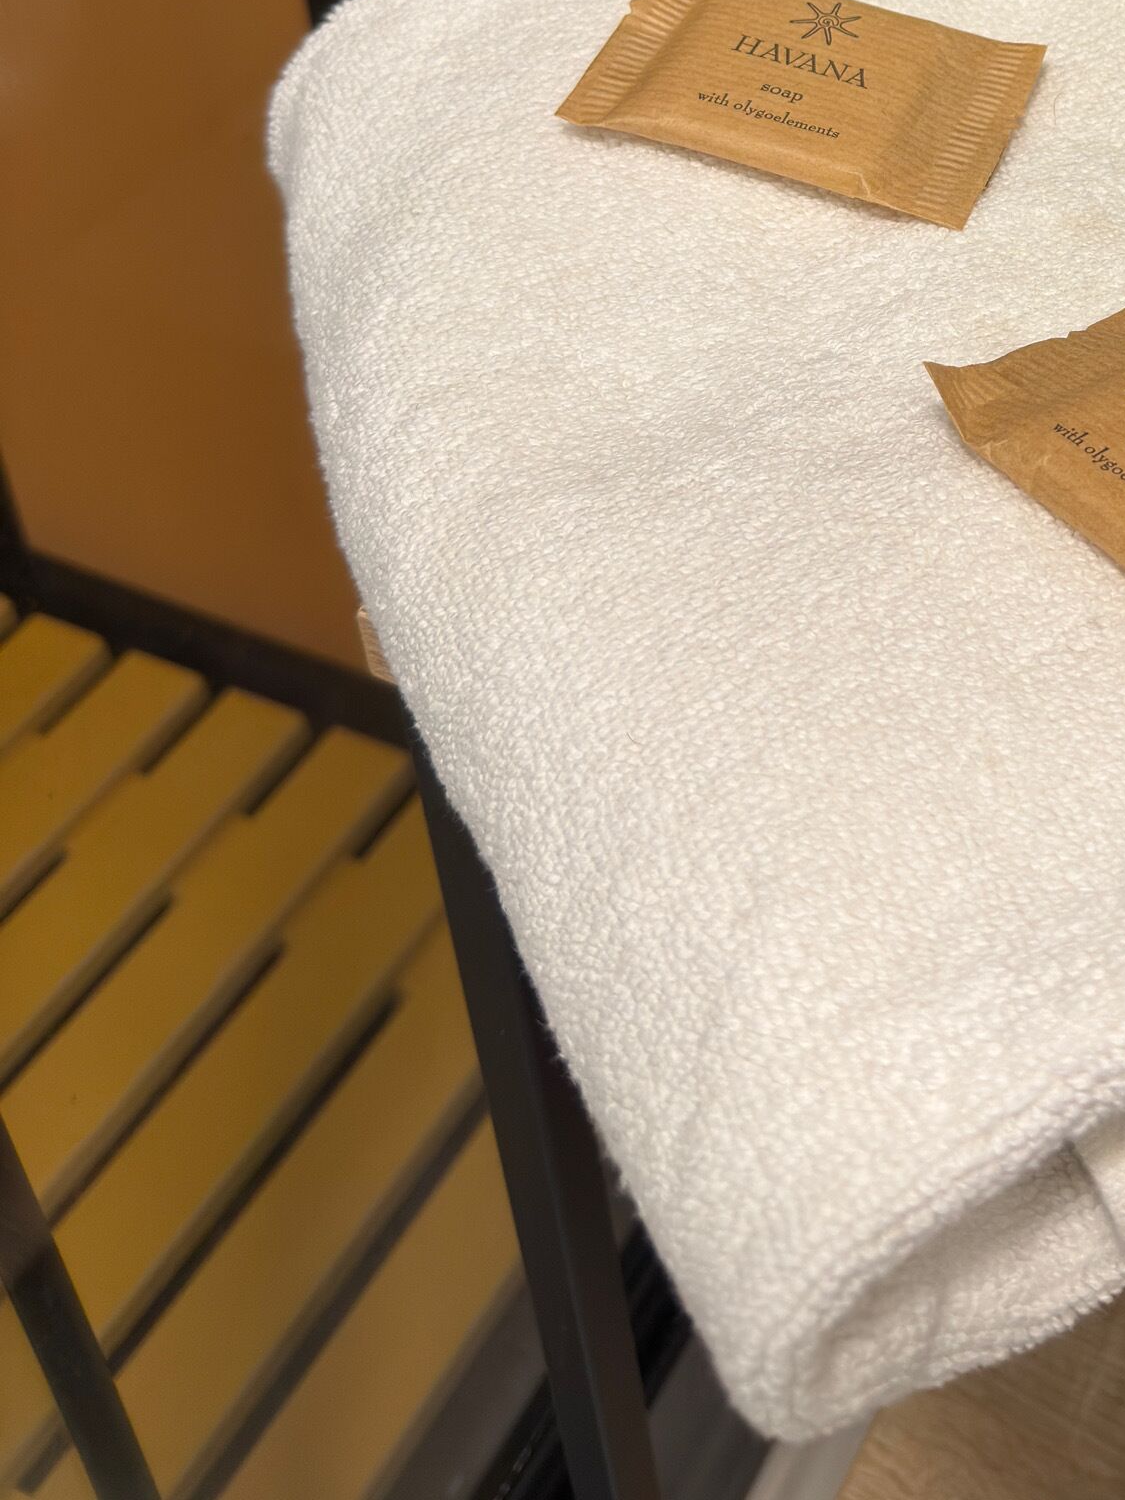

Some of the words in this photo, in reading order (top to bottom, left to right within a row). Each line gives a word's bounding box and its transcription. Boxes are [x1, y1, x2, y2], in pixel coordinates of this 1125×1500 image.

[731, 34, 868, 89] HAVANA
[760, 82, 804, 103] soap
[697, 91, 729, 107] with
[733, 100, 841, 140] olygoelements
[1053, 422, 1089, 447] with
